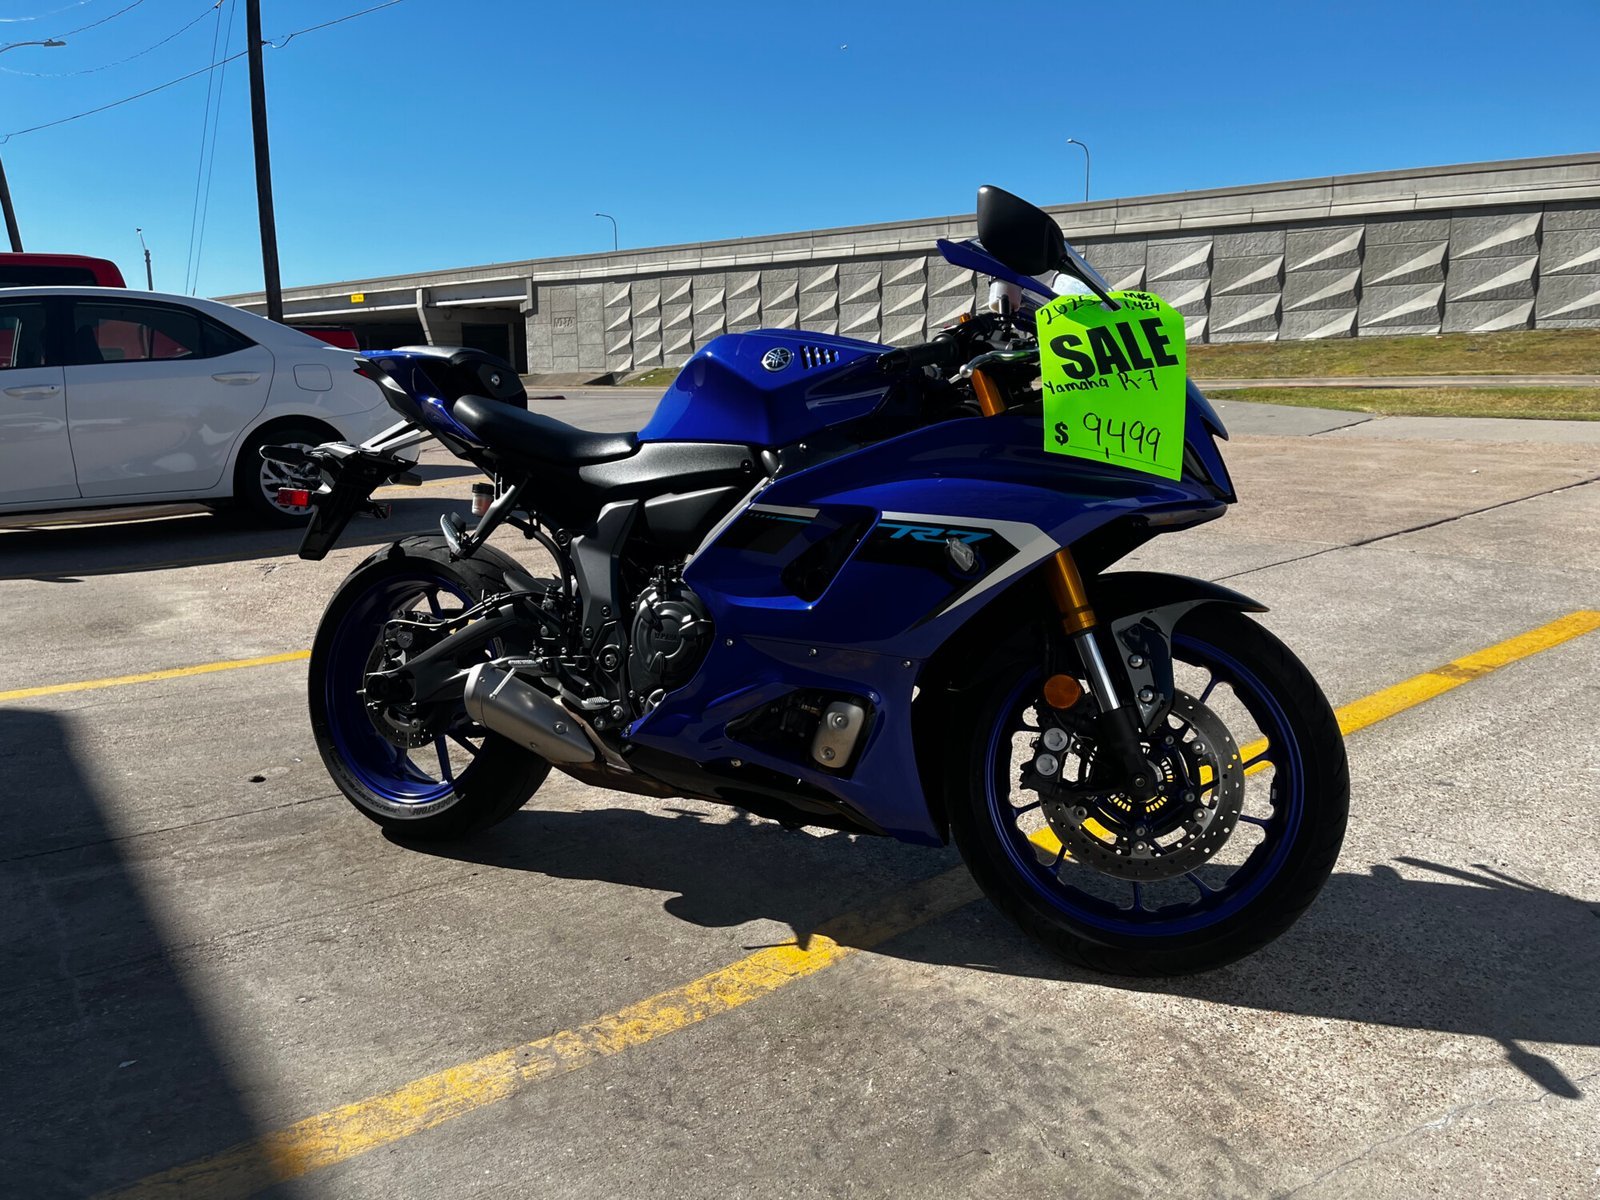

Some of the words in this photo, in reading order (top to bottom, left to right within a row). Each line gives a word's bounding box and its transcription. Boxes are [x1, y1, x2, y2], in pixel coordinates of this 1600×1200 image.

[1040, 295, 1097, 325] 2025
[1124, 301, 1160, 311] 1,424
[1050, 317, 1179, 380] SALE
[1044, 377, 1109, 395] Yamaha
[1117, 370, 1158, 391] R-7
[1054, 421, 1069, 446] $
[1083, 412, 1161, 462] 9,499
